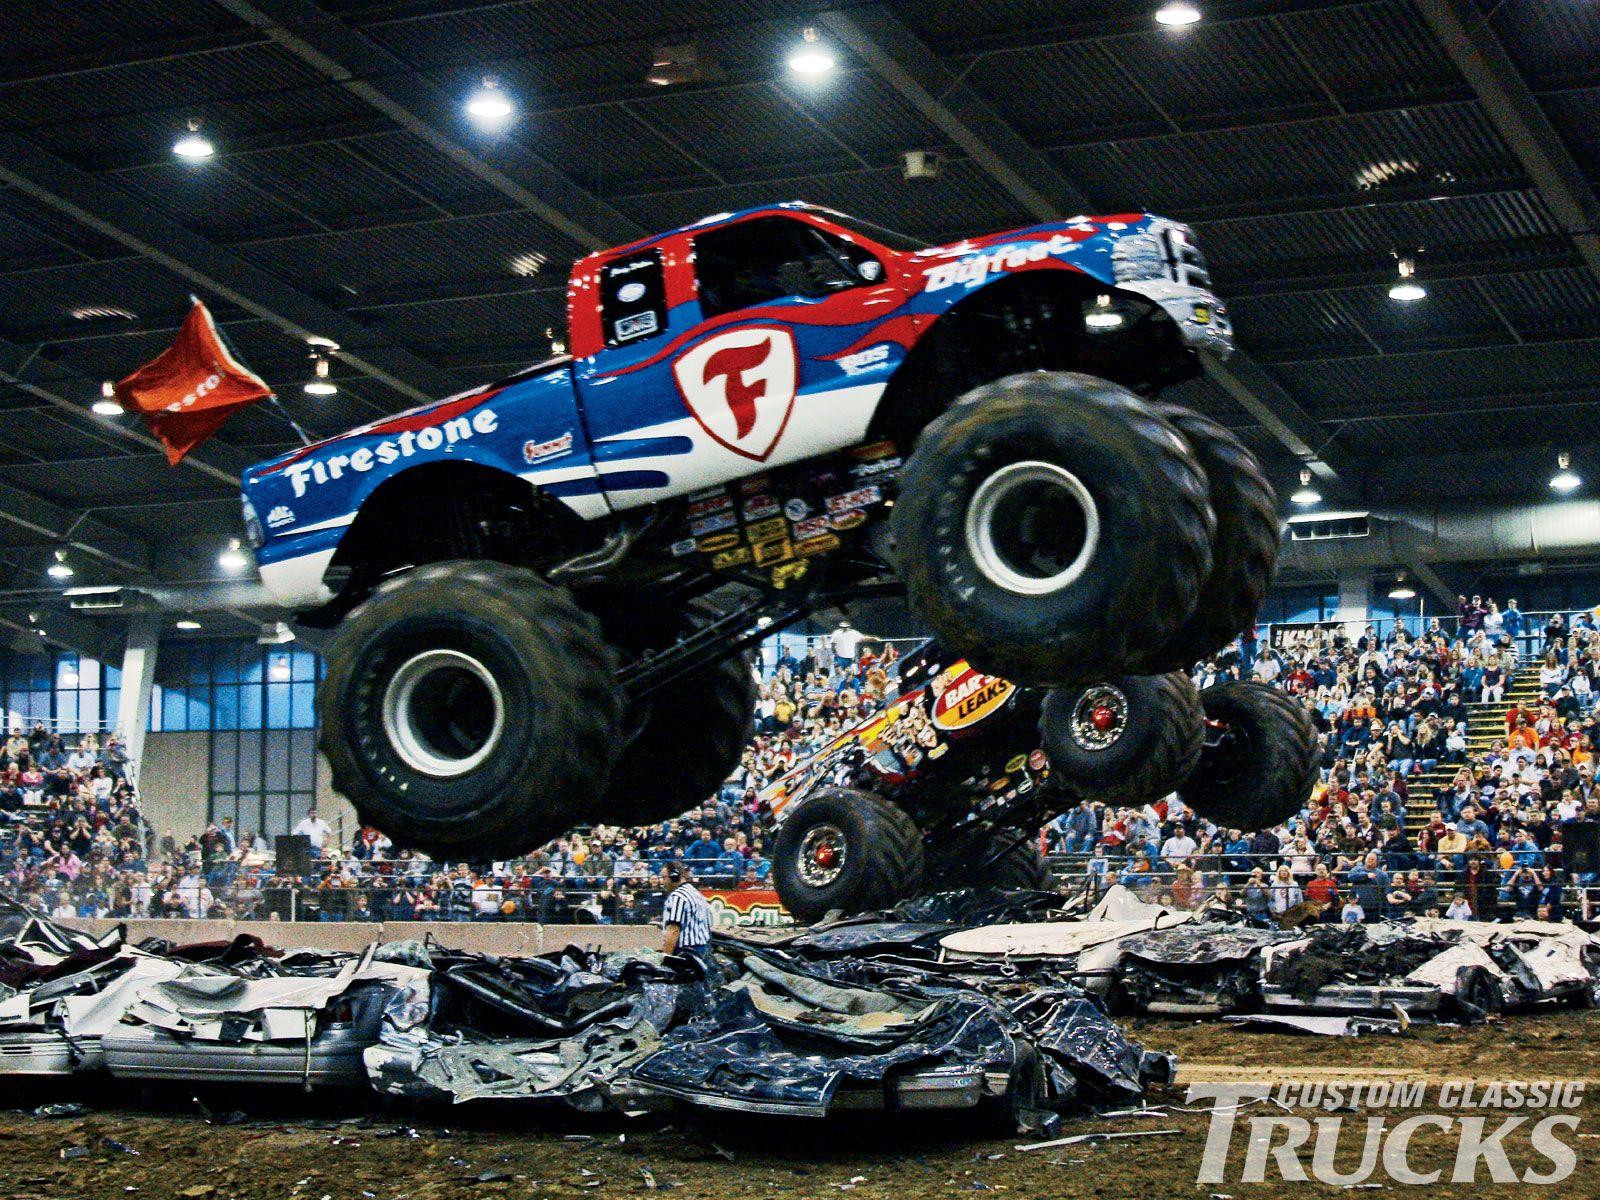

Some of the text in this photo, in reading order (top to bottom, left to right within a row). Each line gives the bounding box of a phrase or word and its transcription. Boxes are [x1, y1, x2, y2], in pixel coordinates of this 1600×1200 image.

[921, 234, 1083, 293] Bigfoot
[284, 408, 499, 498] Firestone
[957, 680, 1009, 719] LEAKS
